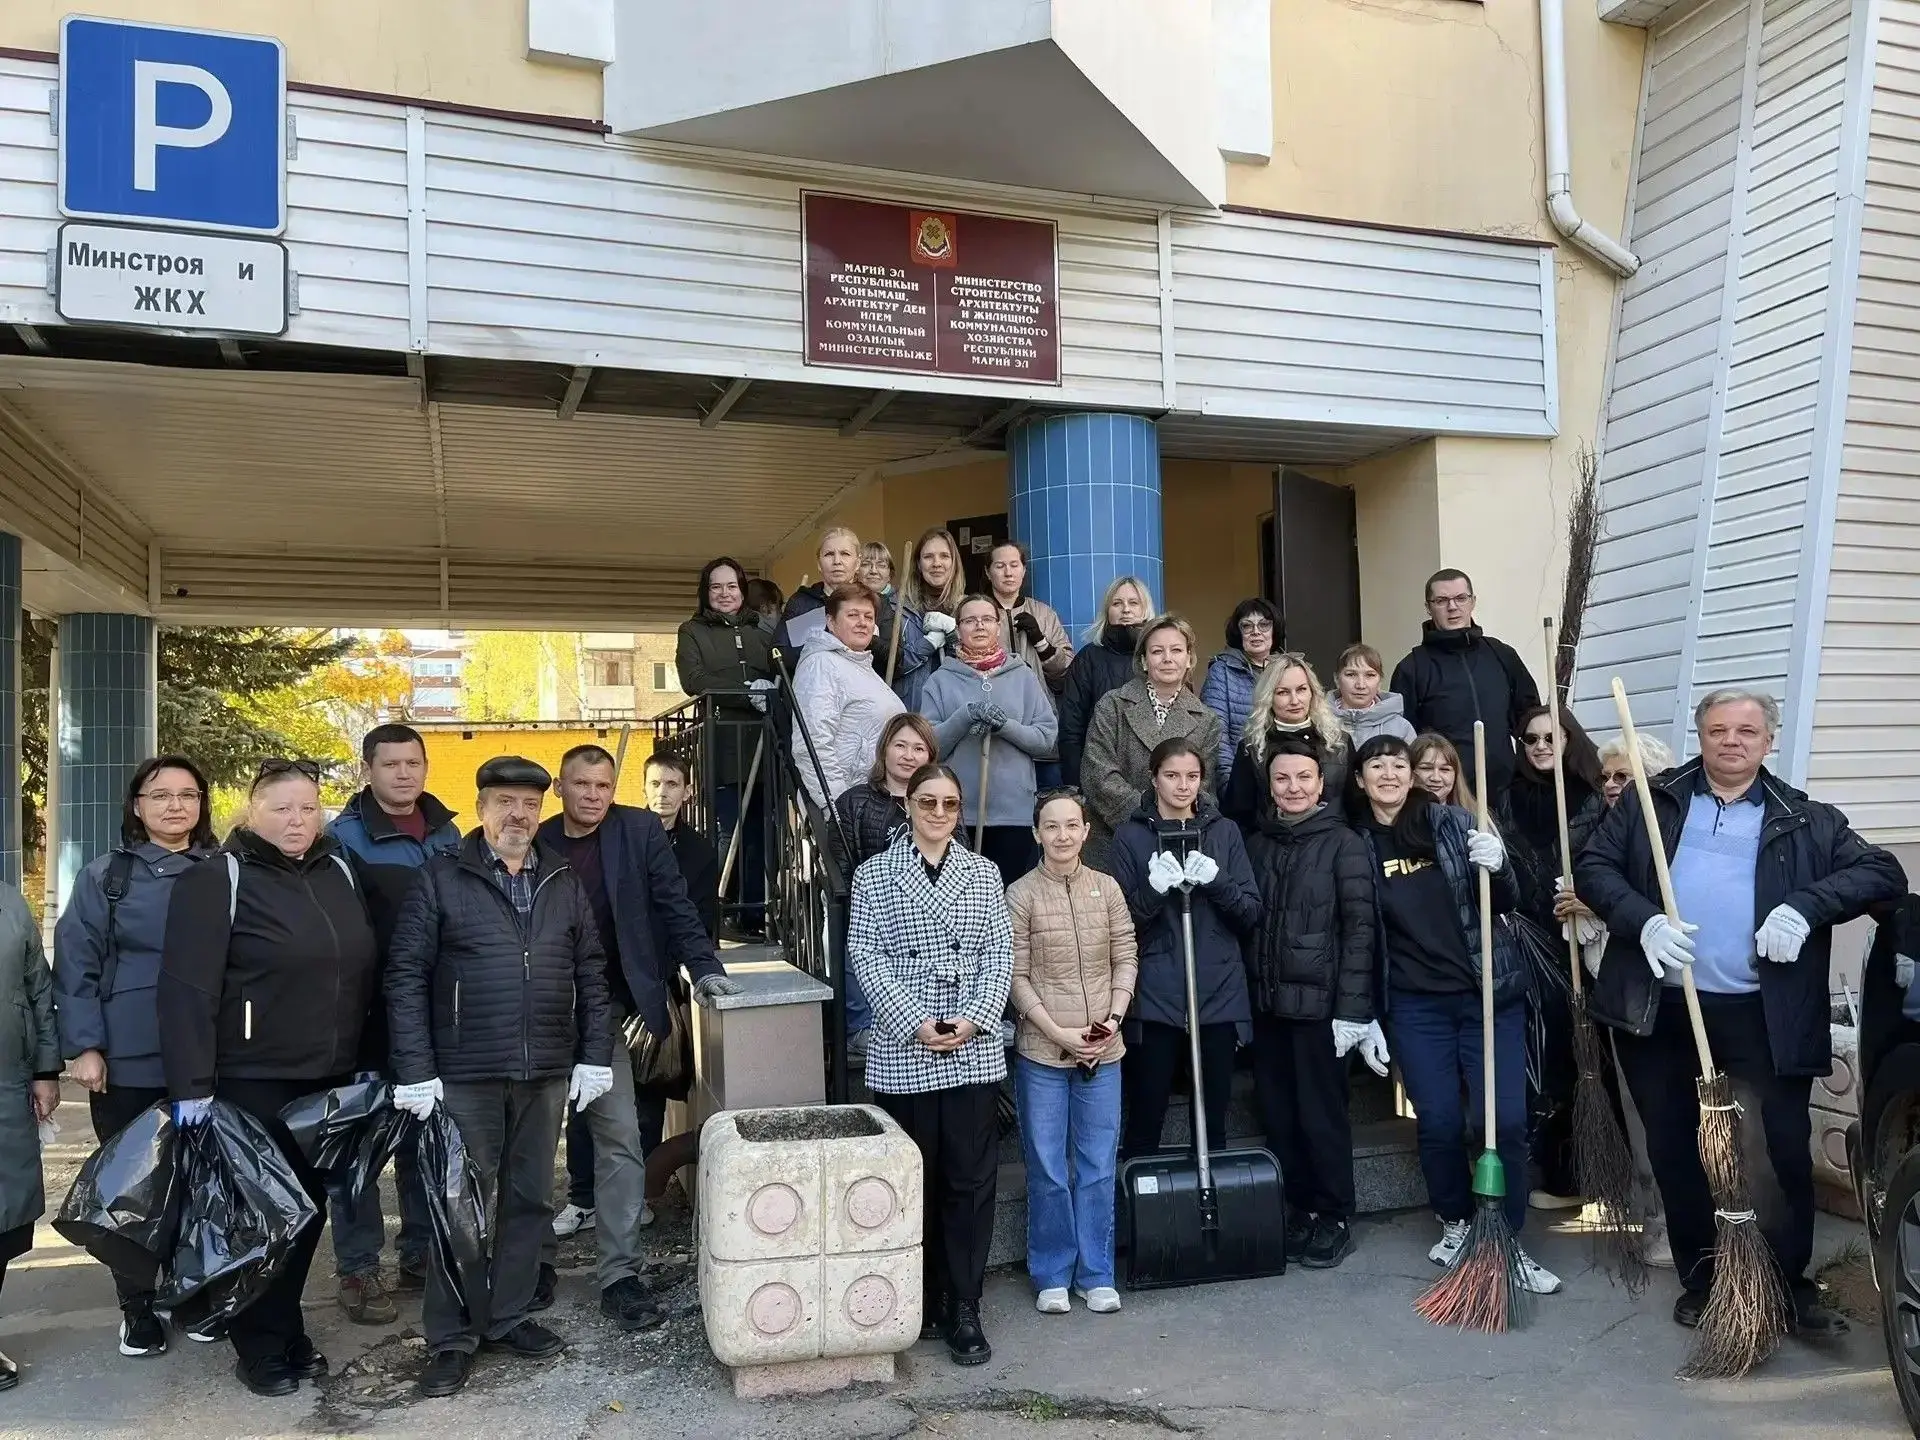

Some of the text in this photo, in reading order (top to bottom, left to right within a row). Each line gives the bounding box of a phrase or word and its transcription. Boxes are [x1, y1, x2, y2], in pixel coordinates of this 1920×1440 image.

[133, 59, 233, 192] P
[68, 241, 254, 281] Минстроя и
[844, 263, 905, 278] МАРИЙ ЭЛ
[830, 273, 919, 292] РЕСПУБЛИКЫН
[954, 275, 1042, 293] МИНИСТЕРСТВО
[134, 285, 206, 315] ЖКХ
[950, 286, 1045, 304] СТРОИТЕЛЬСТВА,
[823, 296, 927, 315] АРХИТЕКТУР ДЕН
[958, 298, 1039, 314] АРХИТЕКТУРЫ
[860, 311, 892, 322] ИЛЕМ
[961, 309, 1037, 325] И ЖИЛИЩНО-
[825, 319, 926, 337] КОММУНАЛЬНЫЙ
[950, 320, 1048, 337] КОММУНАЛЬНОГО
[847, 333, 906, 347] ОЗАНЛЫК
[967, 333, 1033, 347] ХОЗЯЙСТВА
[819, 342, 933, 361] МИНИСТЕРСТВЫЖЕ
[963, 344, 1037, 358] РЕСПУБЛИКИ
[972, 356, 1029, 369] МАРИЙ ЭЛ
